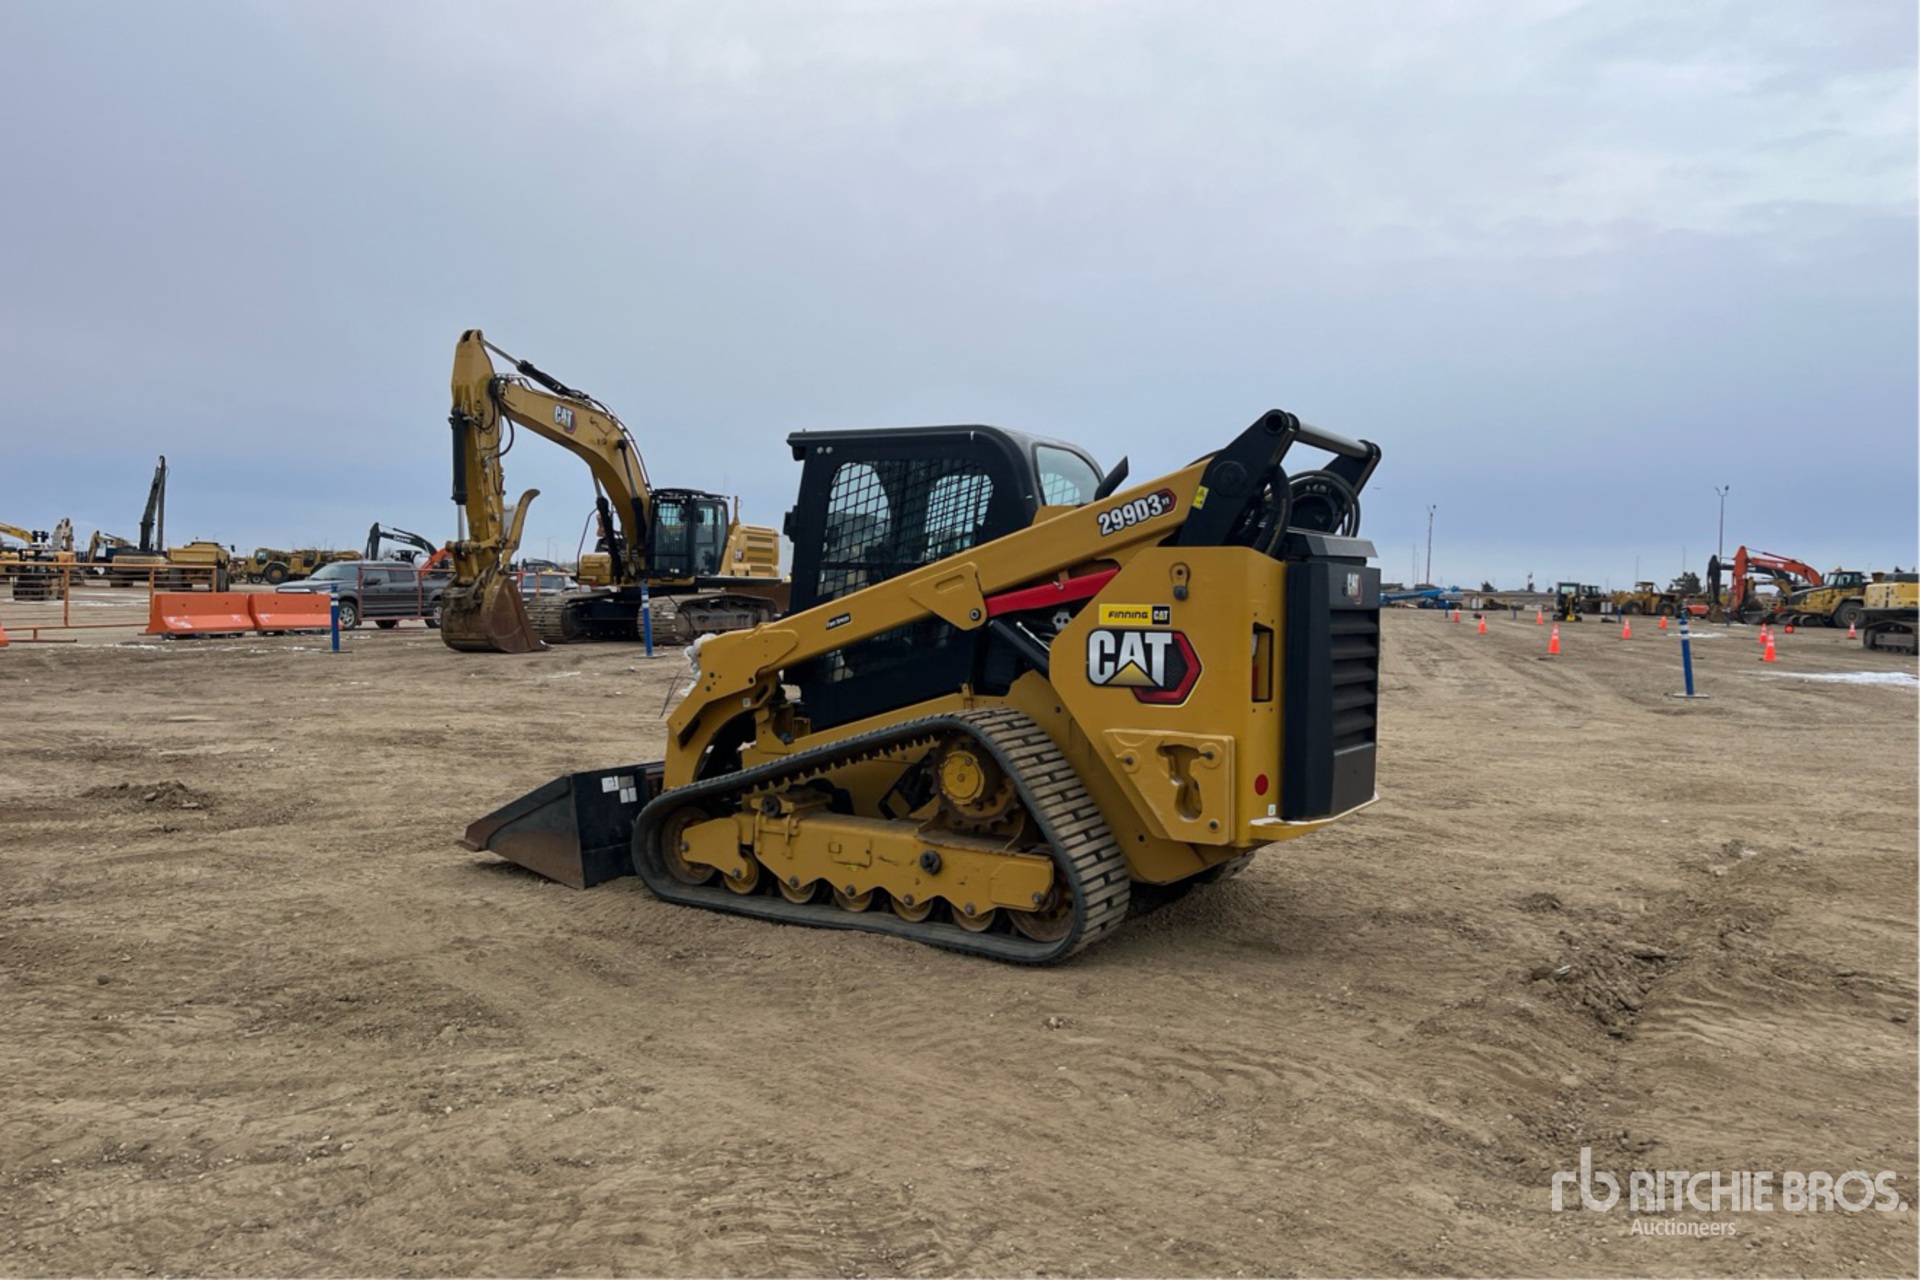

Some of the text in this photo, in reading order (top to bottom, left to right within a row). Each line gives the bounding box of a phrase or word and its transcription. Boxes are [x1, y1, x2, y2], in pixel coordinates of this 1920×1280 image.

[554, 405, 573, 428] CAT
[1098, 494, 1163, 535] 299D3
[1153, 610, 1169, 621] CAT
[1088, 630, 1172, 687] CAT
